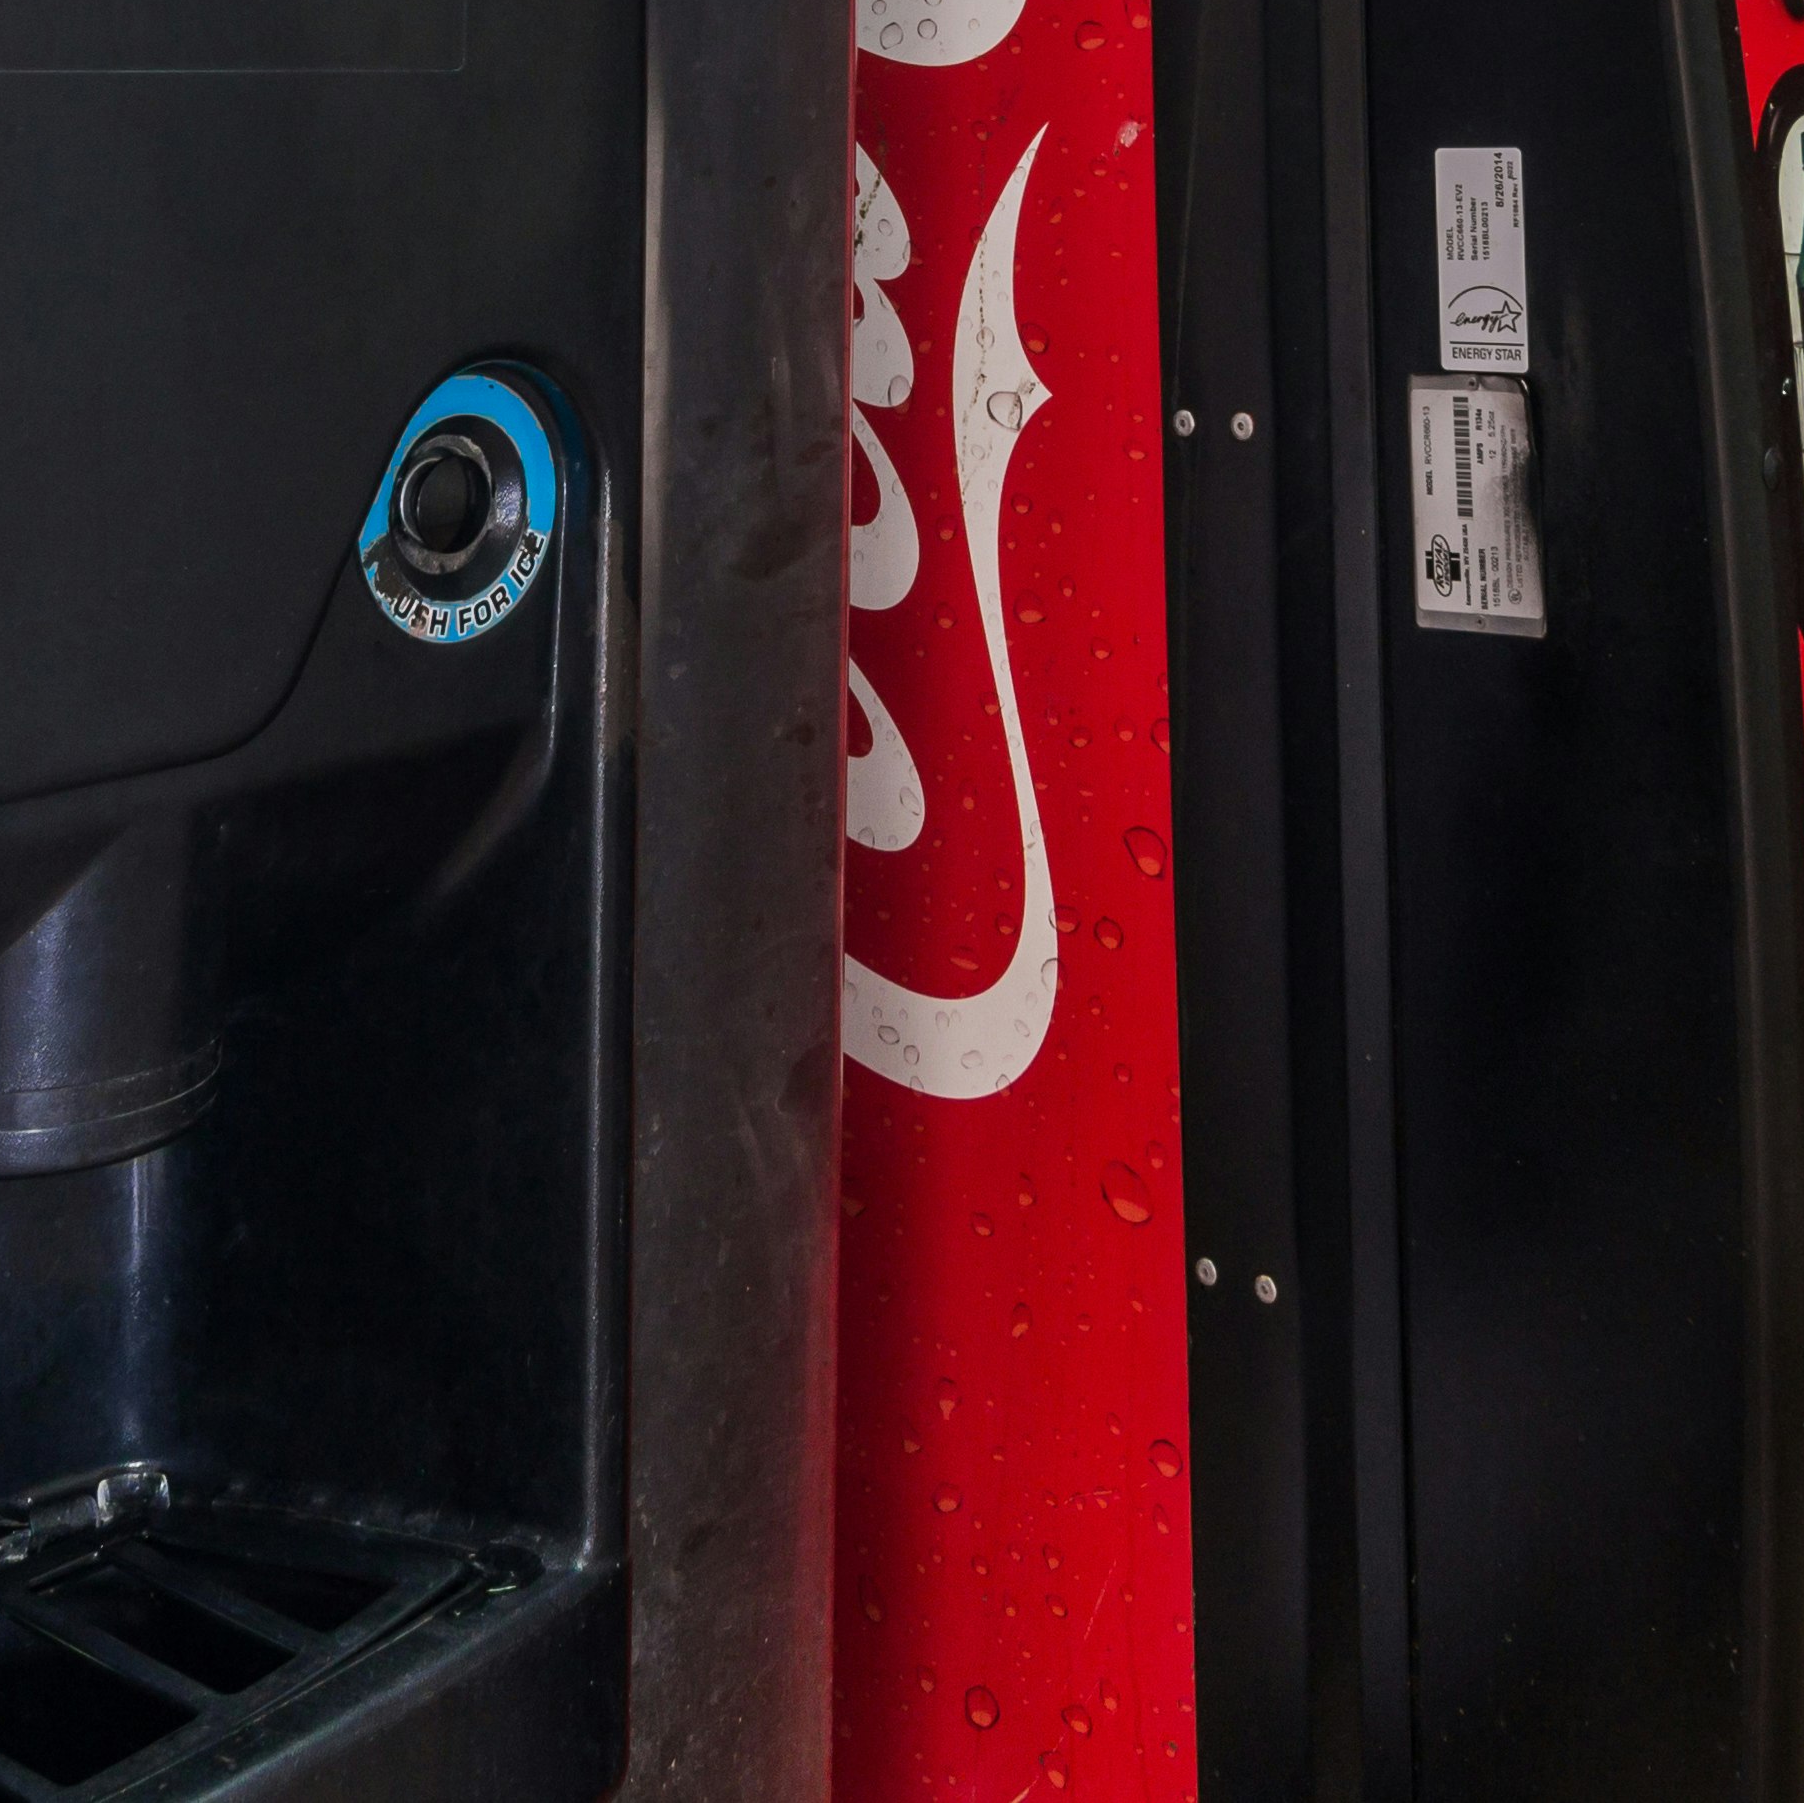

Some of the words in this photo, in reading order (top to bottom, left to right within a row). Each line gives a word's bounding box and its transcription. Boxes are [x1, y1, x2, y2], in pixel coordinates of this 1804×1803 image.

[1493, 152, 1504, 207] 8/26/2014
[1469, 197, 1477, 232] Number
[1470, 235, 1478, 260] Serial
[1450, 310, 1501, 332] energy
[1452, 347, 1494, 361] ENERGY
[1495, 349, 1522, 362] STAR
[1476, 442, 1484, 464] AMPS
[1489, 449, 1496, 458] 12
[1434, 539, 1445, 588] ROYAL
[1478, 548, 1486, 581] NUMBER
[1515, 564, 1523, 587] LISTED
[387, 592, 450, 637] USH
[457, 585, 511, 635] FOR
[508, 529, 548, 587] ICE
[1480, 583, 1488, 609] SERIAL
